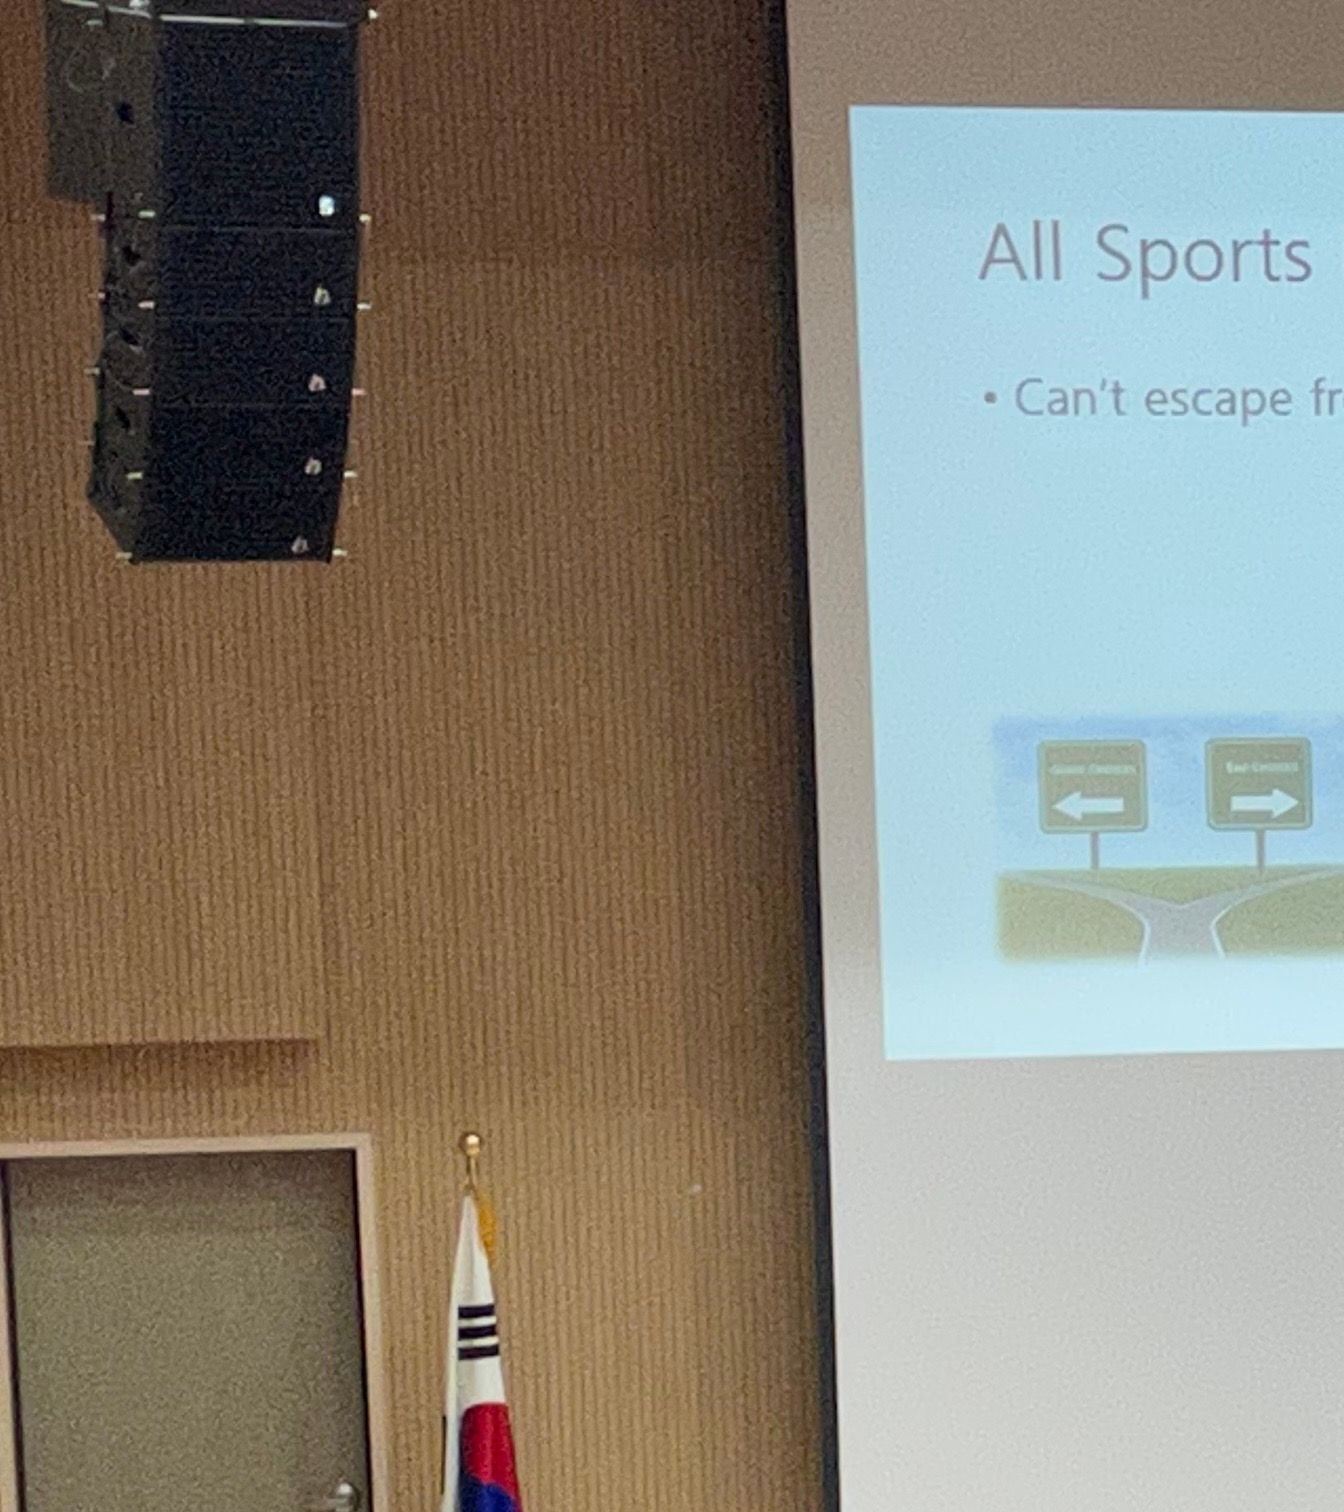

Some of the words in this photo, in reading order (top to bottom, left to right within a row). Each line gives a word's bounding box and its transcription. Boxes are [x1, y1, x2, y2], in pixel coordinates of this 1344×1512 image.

[979, 219, 1062, 282] All
[1096, 223, 1313, 300] Sports
[1143, 387, 1293, 428] escape
